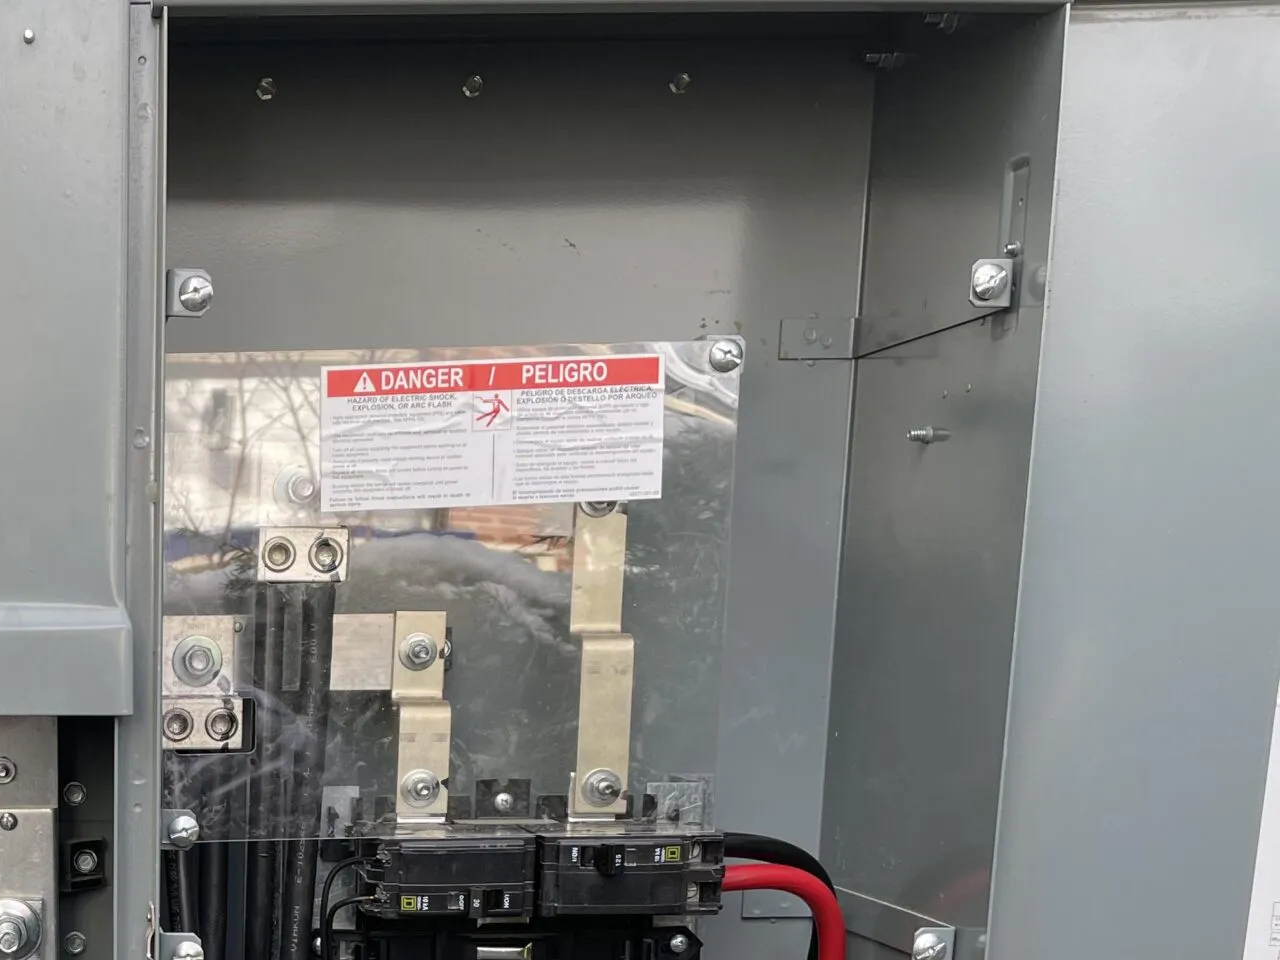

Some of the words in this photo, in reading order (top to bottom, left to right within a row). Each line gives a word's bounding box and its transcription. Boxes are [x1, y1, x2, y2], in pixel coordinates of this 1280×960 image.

[381, 367, 464, 390] DANGER
[521, 362, 608, 384] PELIGRO
[473, 899, 480, 908] 30
